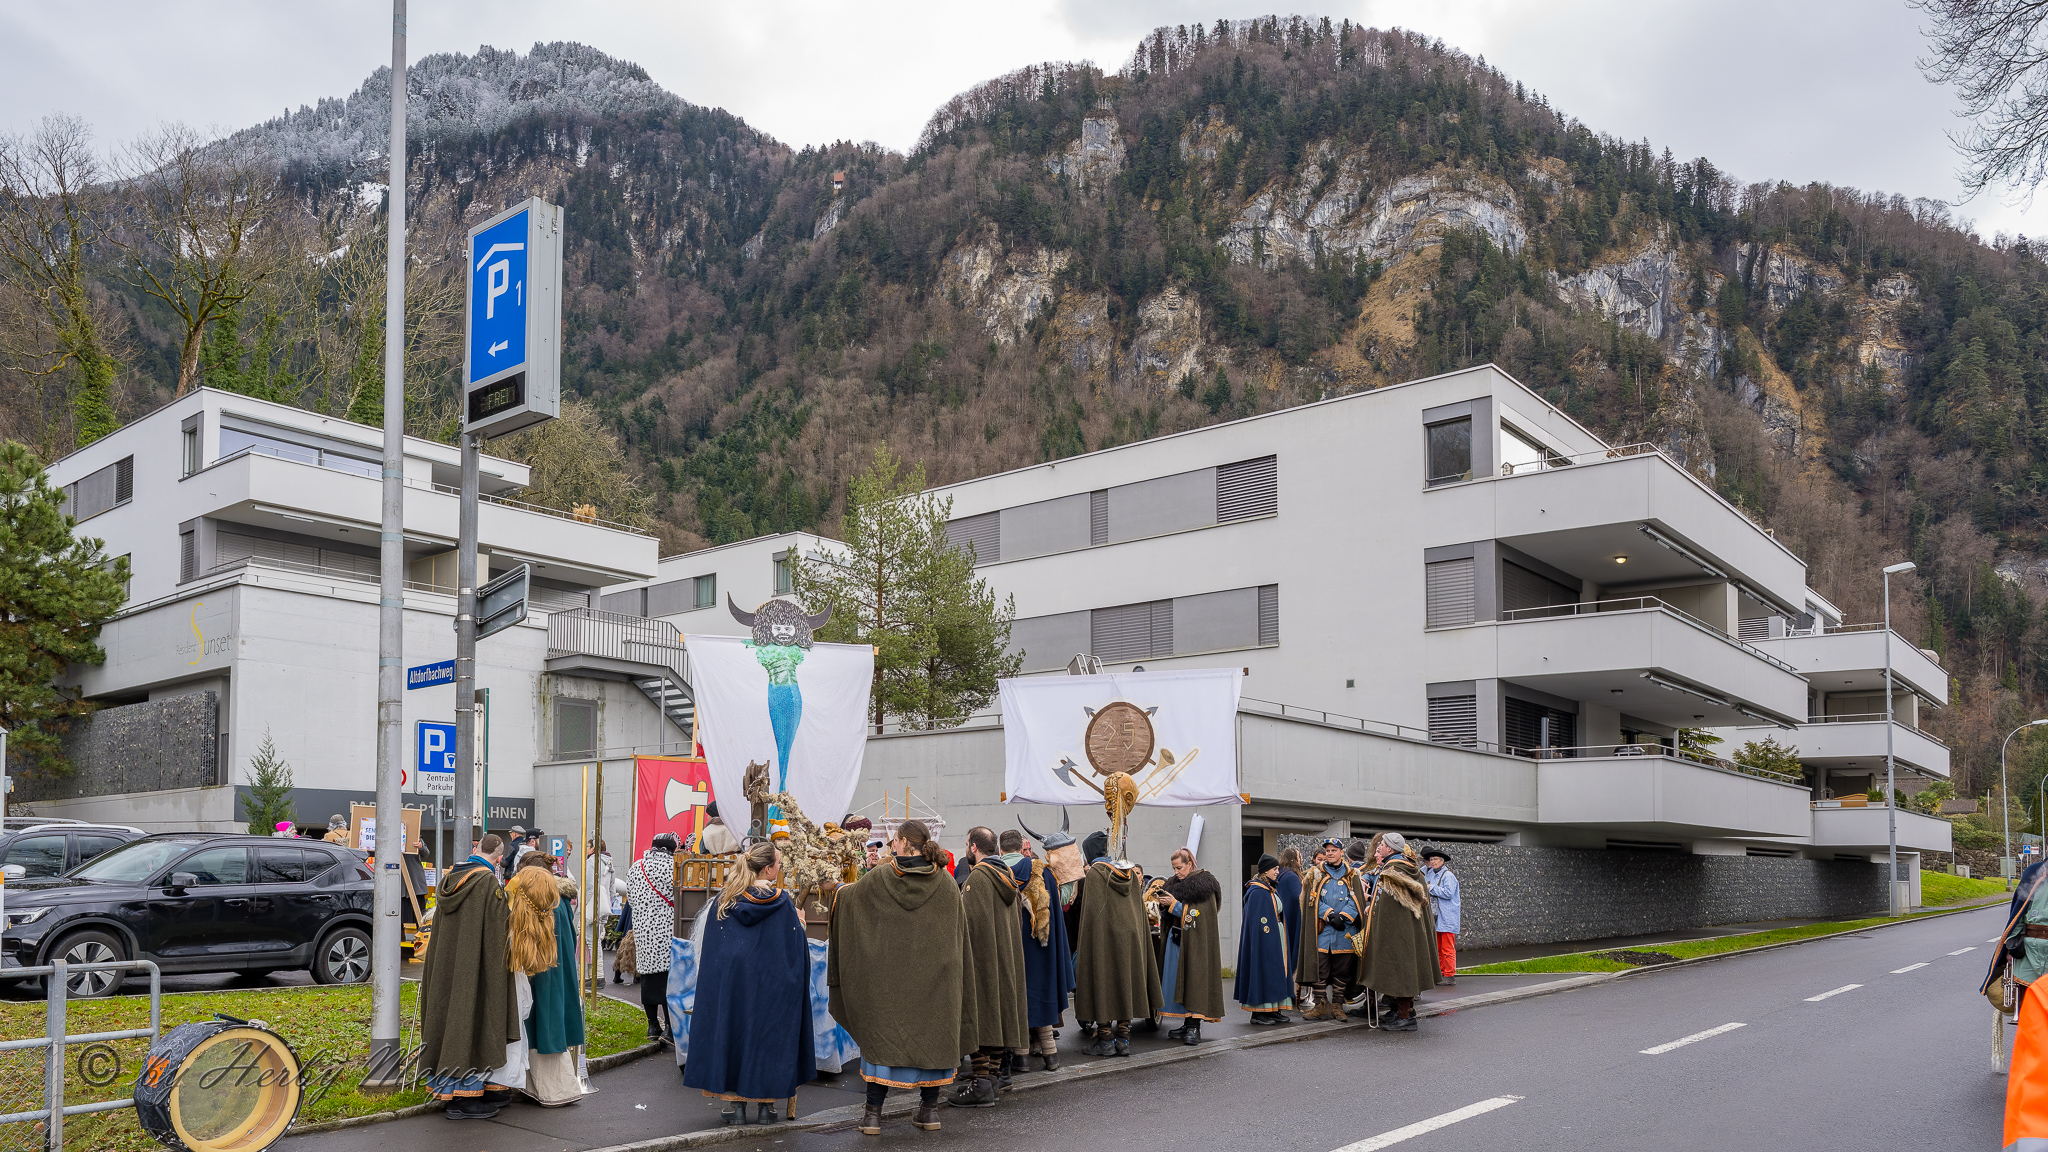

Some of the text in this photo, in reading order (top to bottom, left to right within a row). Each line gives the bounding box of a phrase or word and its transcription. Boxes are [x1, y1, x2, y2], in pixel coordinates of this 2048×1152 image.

[488, 387, 509, 410] FREI
[410, 666, 453, 684] Altdorfbachweg
[1103, 721, 1135, 750] 25
[424, 728, 445, 765] P
[426, 773, 455, 783] Zentrale
[427, 782, 454, 791] Parkuhr
[552, 839, 563, 856] P
